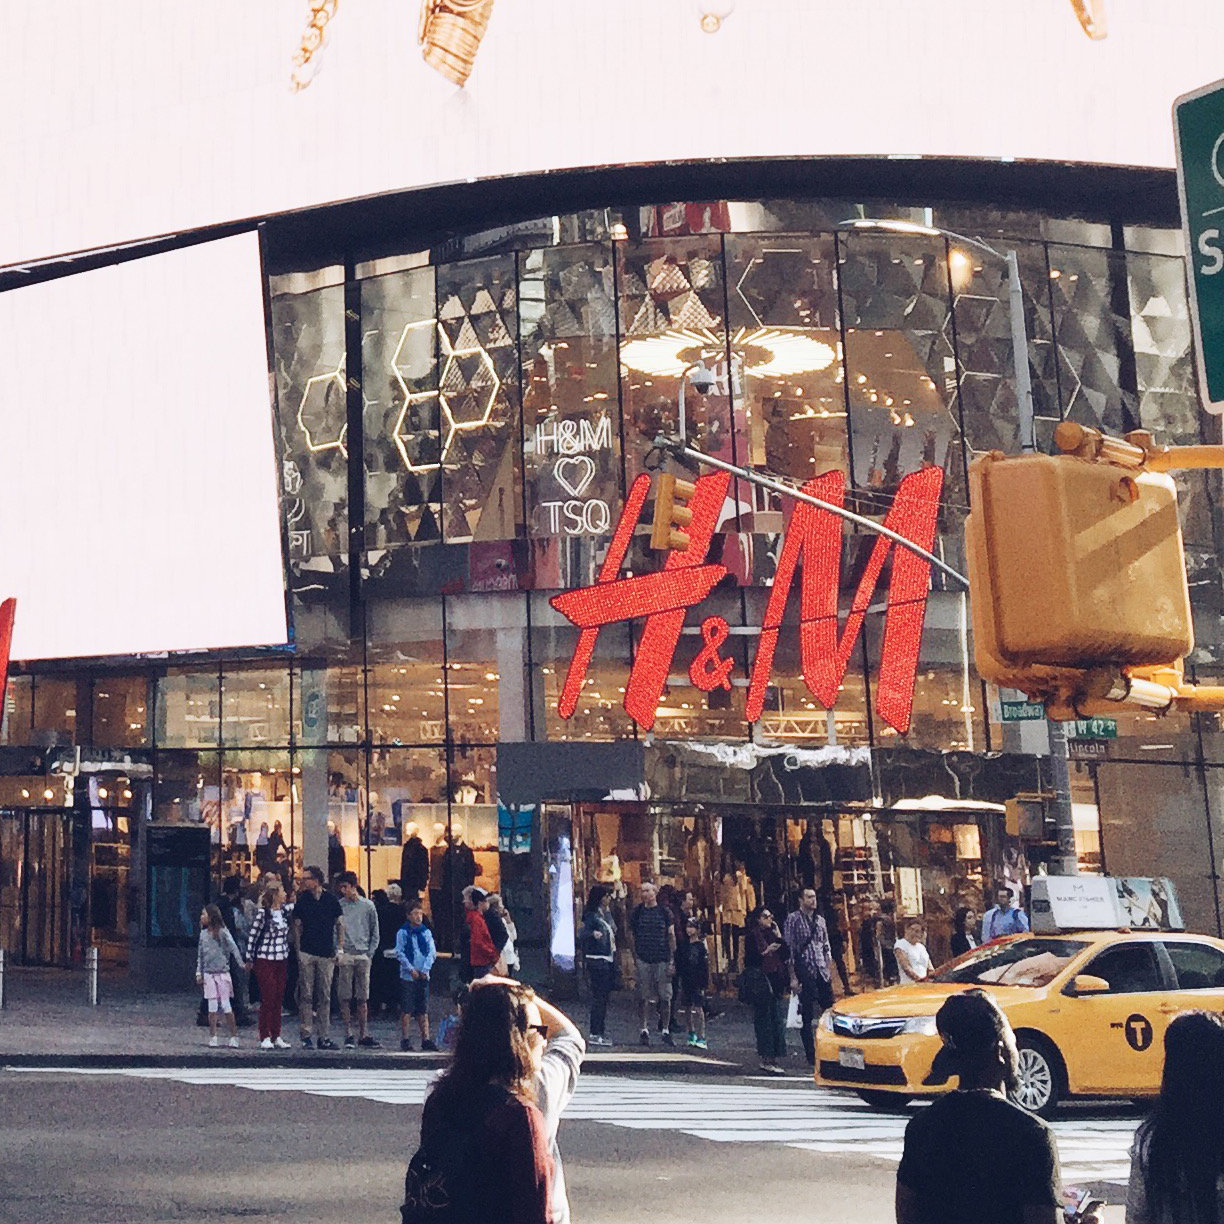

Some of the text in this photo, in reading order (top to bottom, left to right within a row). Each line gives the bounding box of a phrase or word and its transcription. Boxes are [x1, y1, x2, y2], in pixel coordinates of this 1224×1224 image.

[536, 415, 613, 455] H&M
[541, 499, 611, 535] TSQ
[549, 465, 945, 737] H&M
[1003, 702, 1044, 720] Broadway
[1077, 721, 1087, 734] W
[1092, 719, 1104, 735] 42
